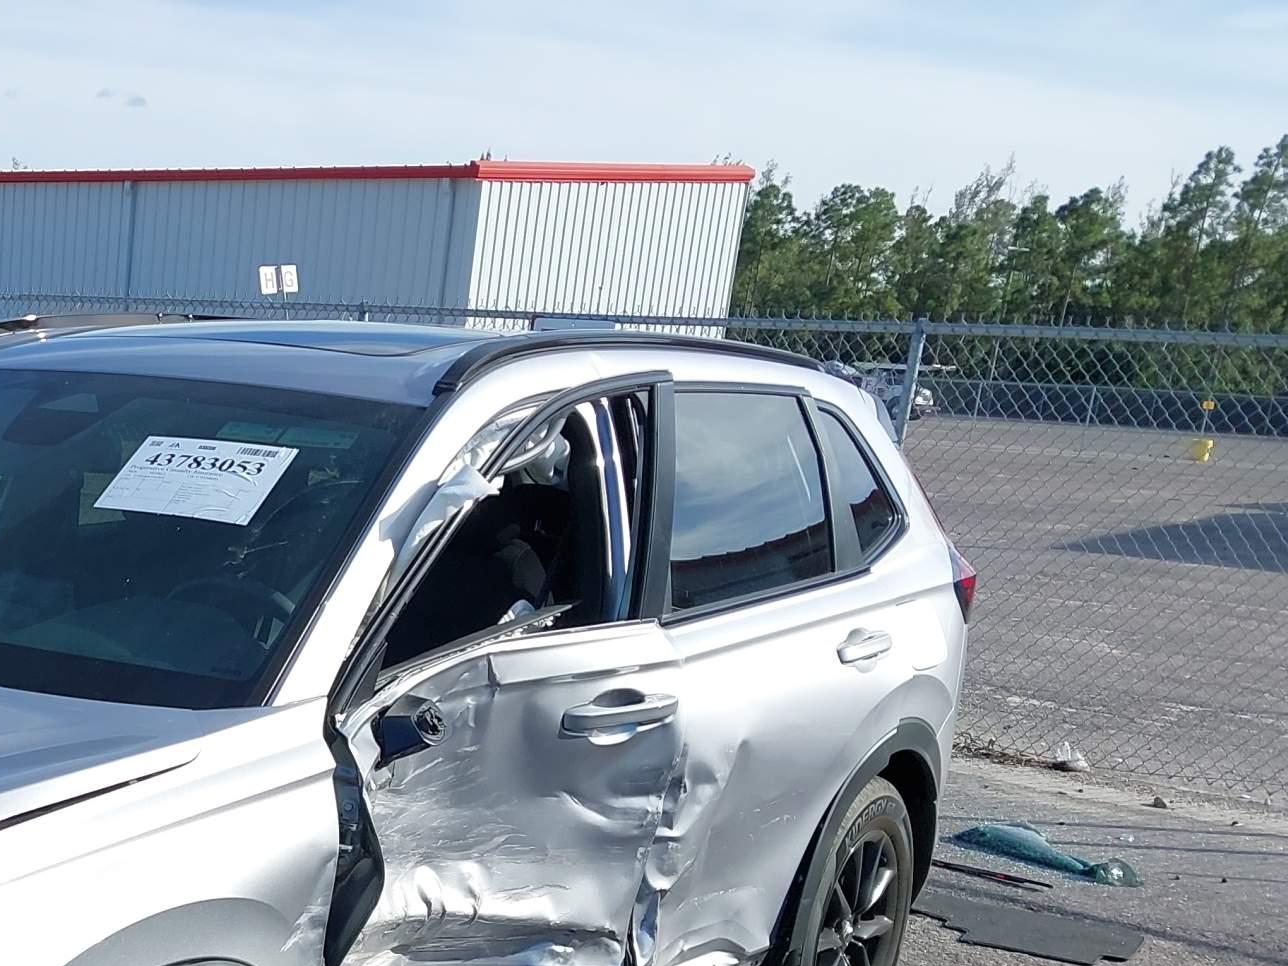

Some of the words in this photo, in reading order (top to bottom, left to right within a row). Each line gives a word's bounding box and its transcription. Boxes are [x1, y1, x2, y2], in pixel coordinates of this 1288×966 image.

[264, 271, 275, 289] H
[284, 270, 294, 288] G
[145, 452, 266, 476] 43783053
